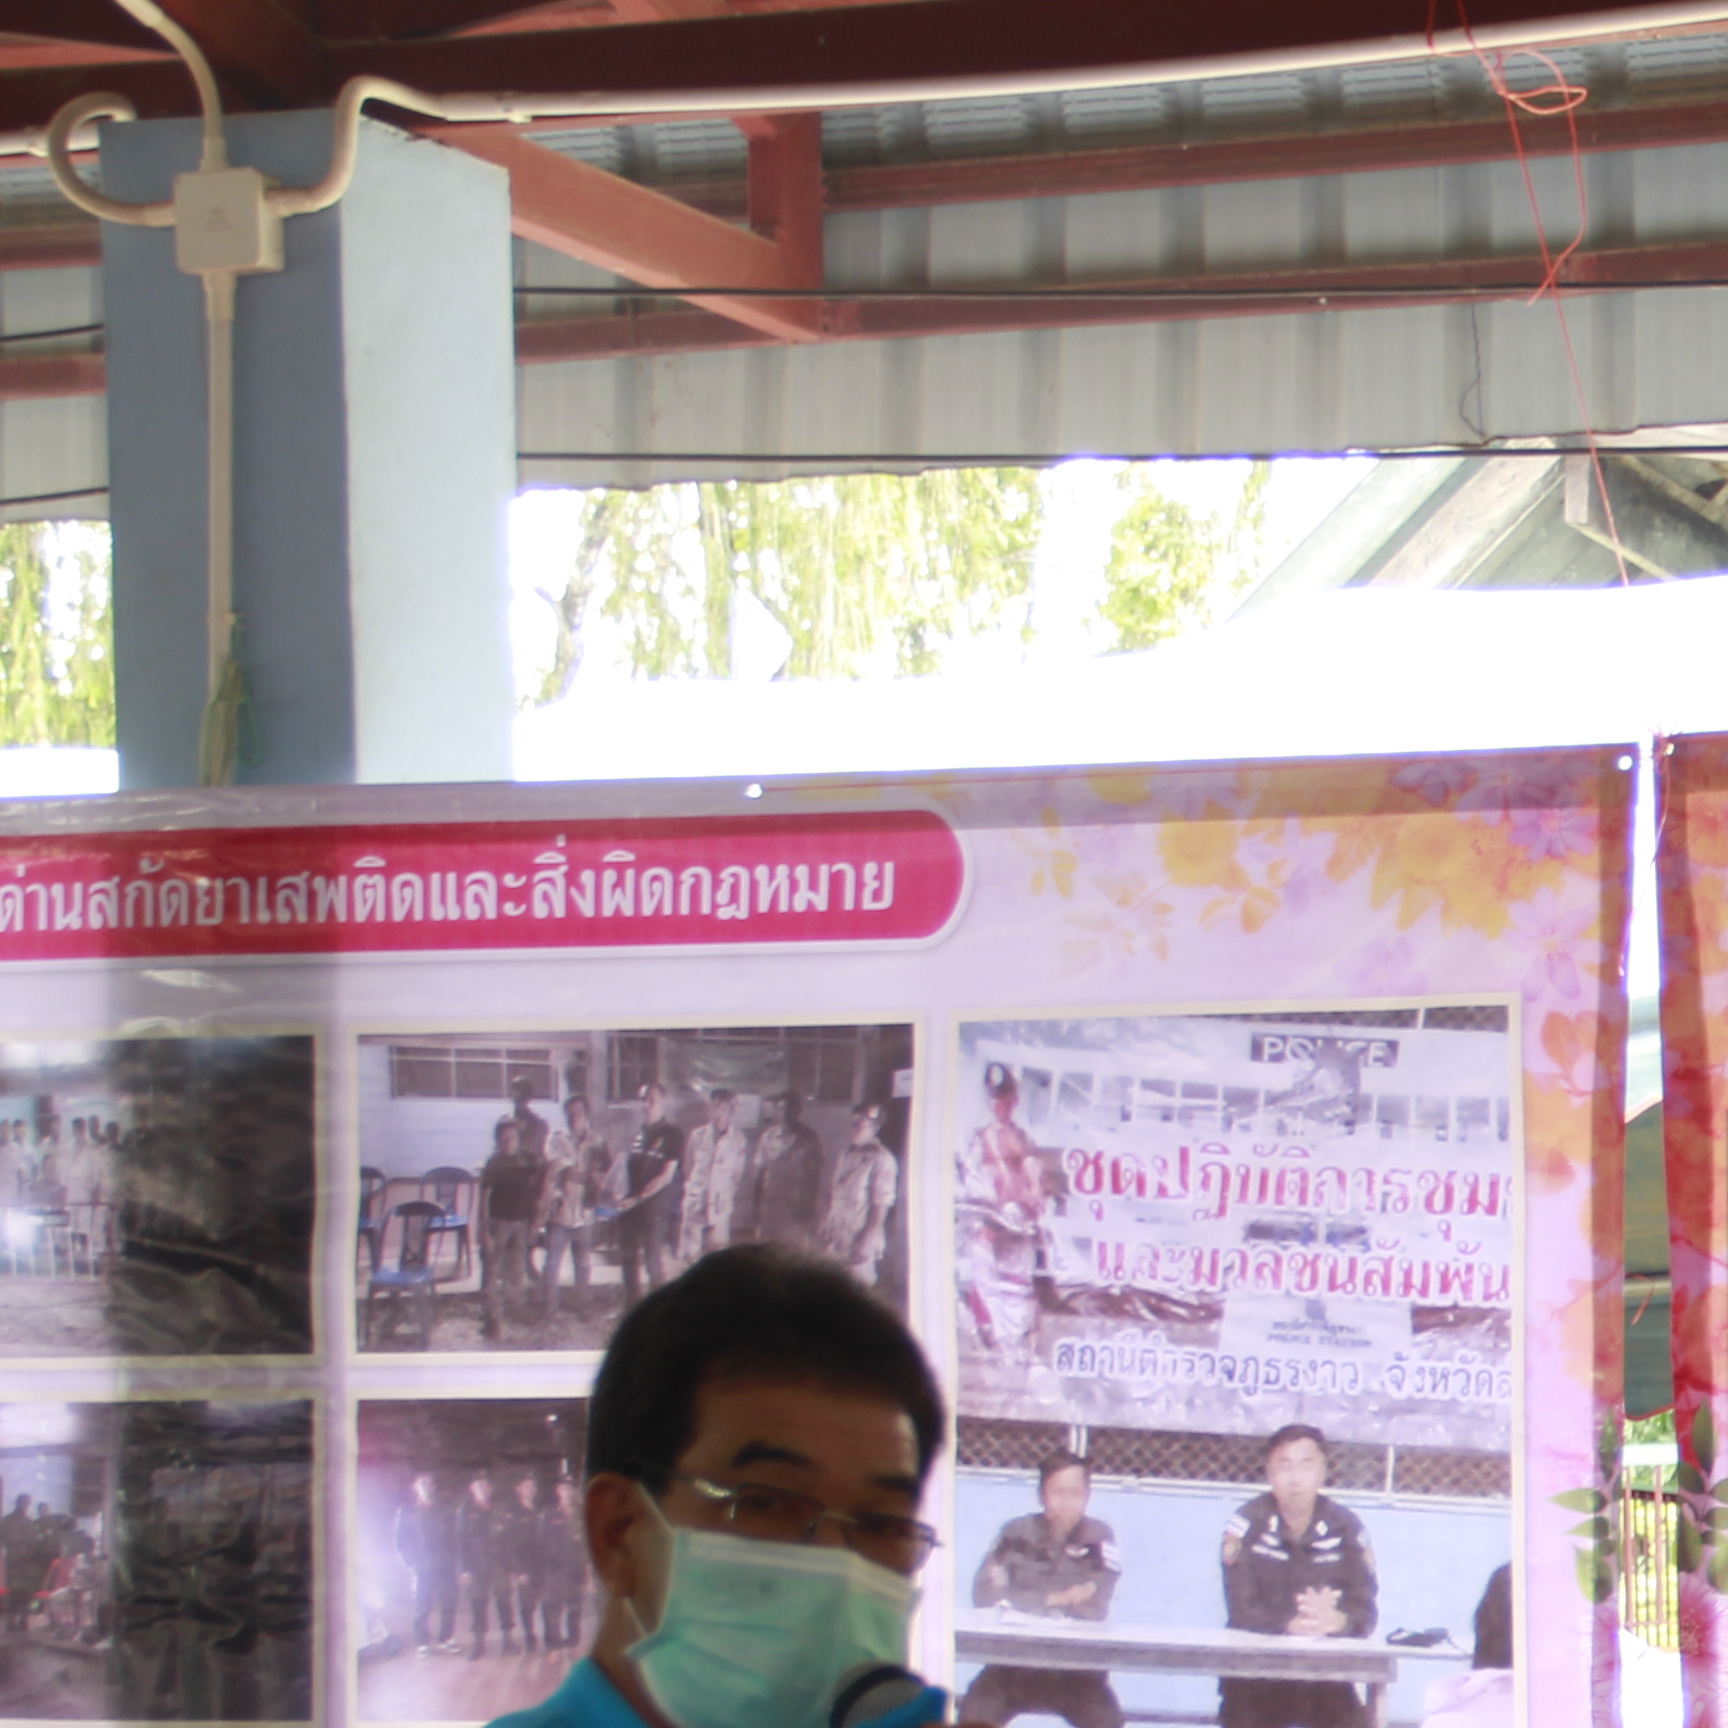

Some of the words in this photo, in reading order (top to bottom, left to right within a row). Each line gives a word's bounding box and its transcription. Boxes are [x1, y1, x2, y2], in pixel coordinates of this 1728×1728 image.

[1262, 1036, 1388, 1067] POCE
[1067, 1143, 1512, 1242] ชุดปฏิบัติการชุม
